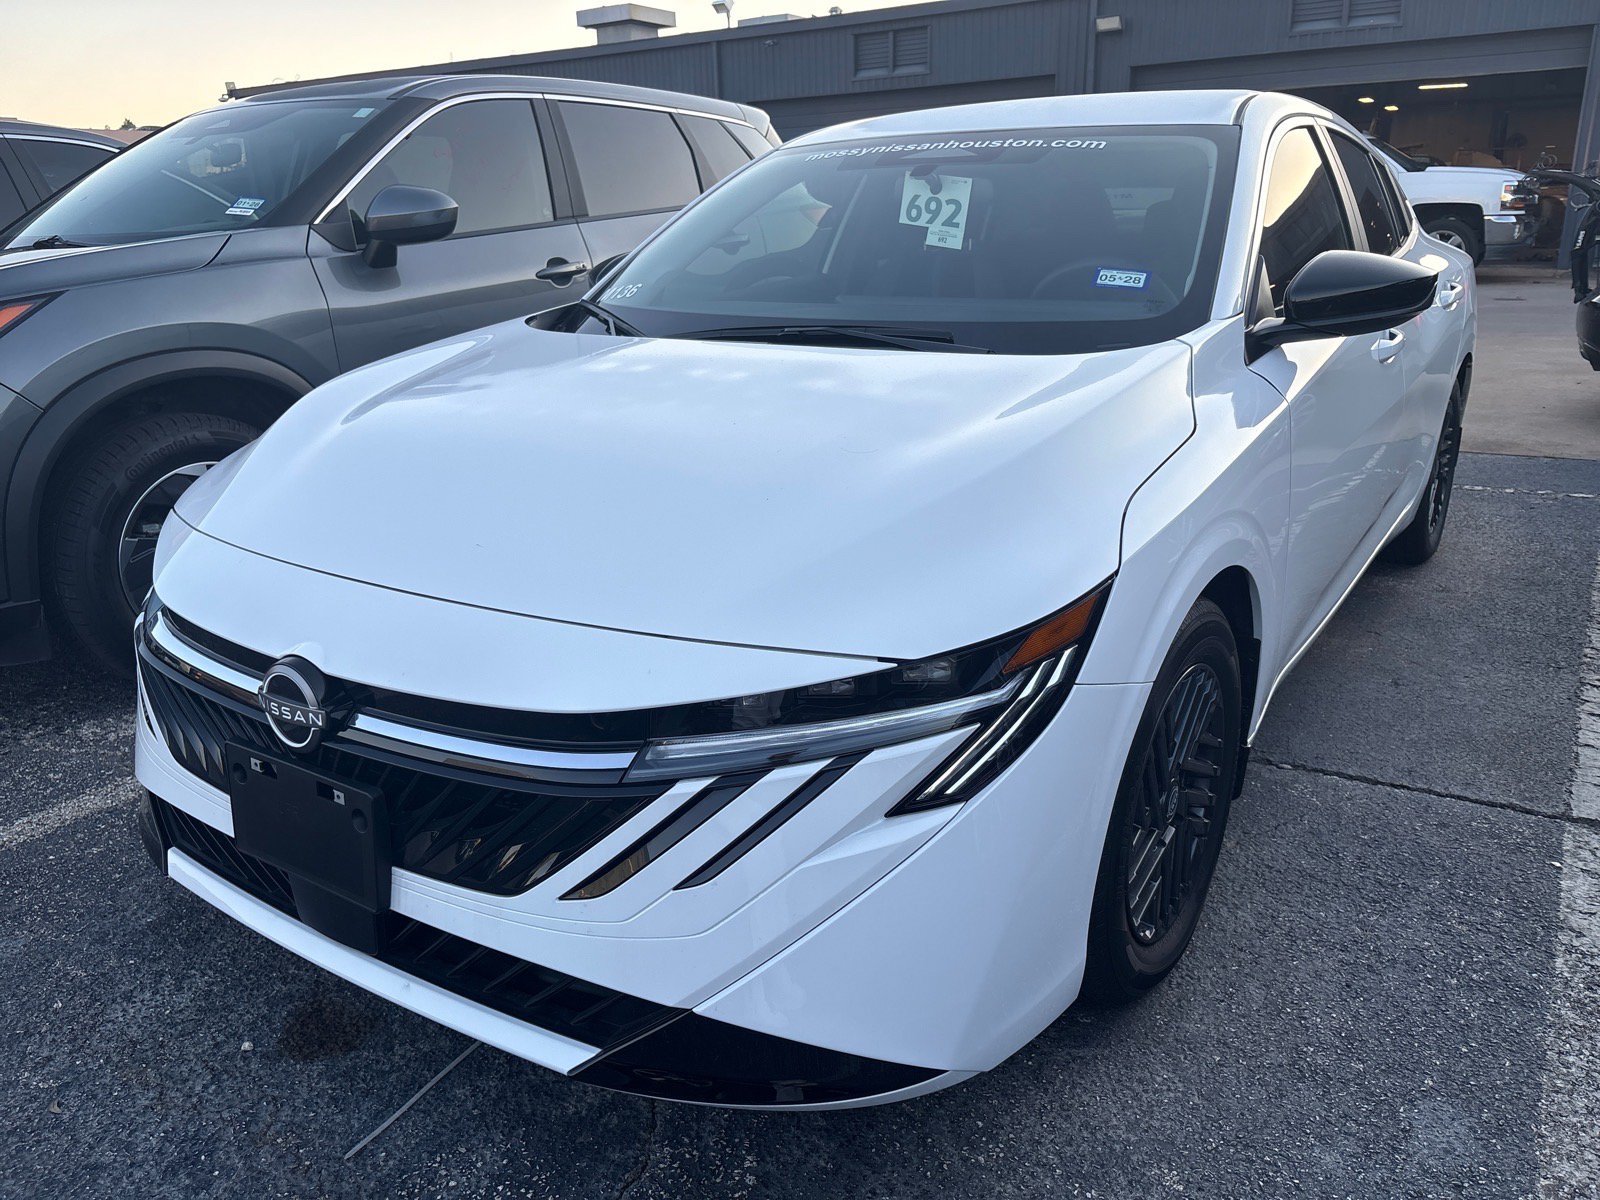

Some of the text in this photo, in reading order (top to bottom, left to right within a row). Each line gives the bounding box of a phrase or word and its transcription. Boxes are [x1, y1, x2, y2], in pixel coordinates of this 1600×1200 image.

[803, 137, 1107, 162] mossynissanhouston.com
[905, 194, 962, 229] 692
[258, 693, 323, 727] NISSAN
